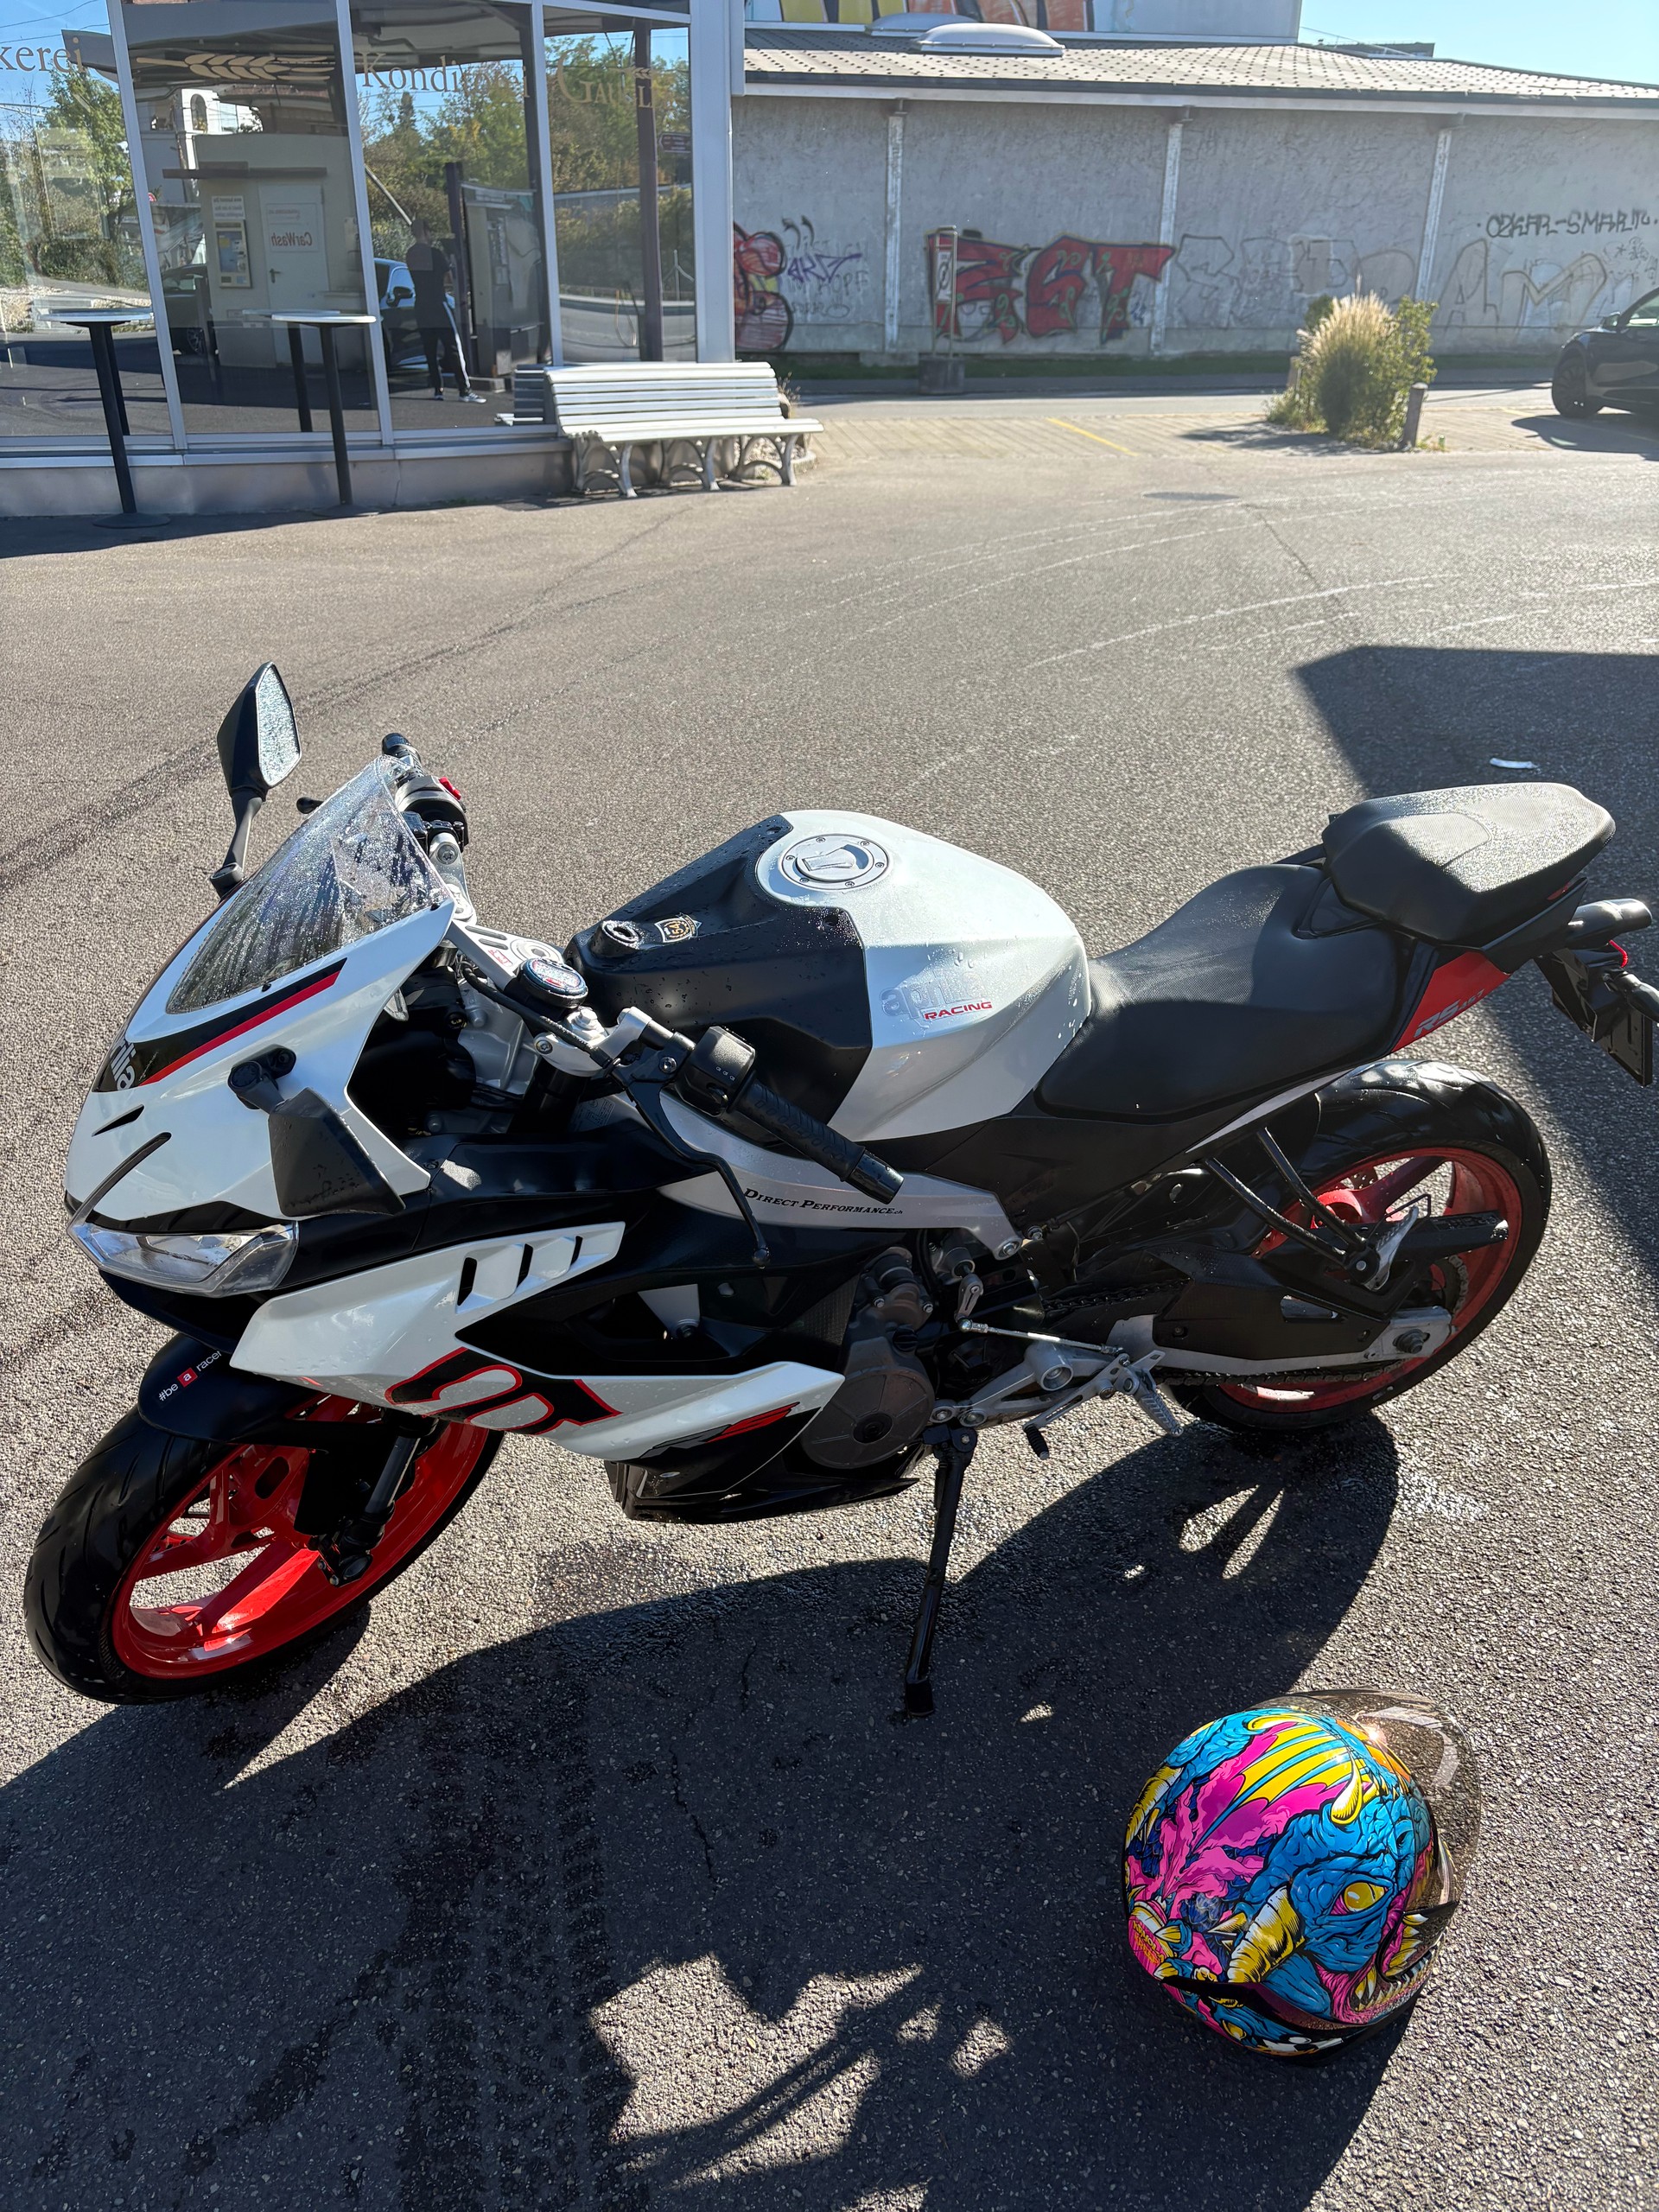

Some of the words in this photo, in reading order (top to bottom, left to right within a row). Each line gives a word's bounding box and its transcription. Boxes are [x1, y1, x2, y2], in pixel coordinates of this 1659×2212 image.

[924, 1001, 993, 1020] RACING
[1414, 999, 1460, 1038] RS
[744, 1187, 799, 1208] DIRECT
[158, 1383, 179, 1402] #be
